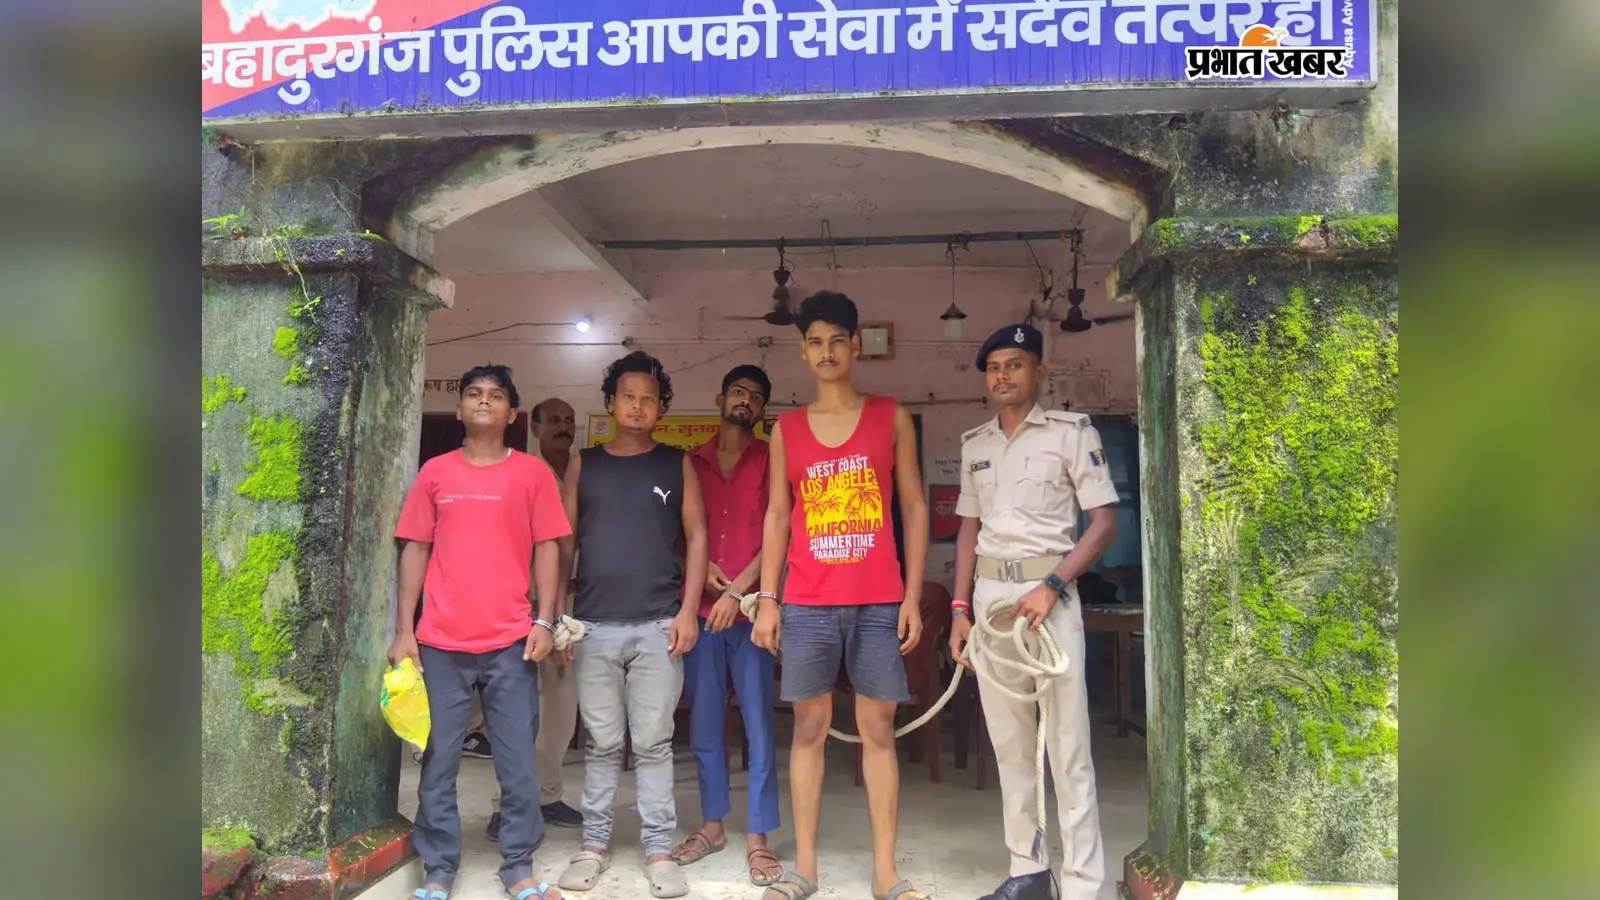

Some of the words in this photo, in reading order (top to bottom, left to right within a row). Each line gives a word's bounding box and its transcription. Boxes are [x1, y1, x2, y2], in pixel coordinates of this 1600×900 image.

[1341, 0, 1354, 26] Adv
[441, 6, 594, 97] पुलिस
[597, 0, 781, 66] आपकी
[788, 0, 901, 58] सेवा
[965, 0, 1107, 52] सदव
[1111, 0, 1270, 45] तत्पर
[806, 463, 835, 479] WEST
[838, 456, 868, 473] COAST
[800, 477, 823, 497] LOS
[807, 518, 882, 537] CALIFORNIA
[809, 533, 875, 551] SUMMERTIME
[814, 549, 851, 560] PARADISE
[852, 547, 868, 558] CITY
